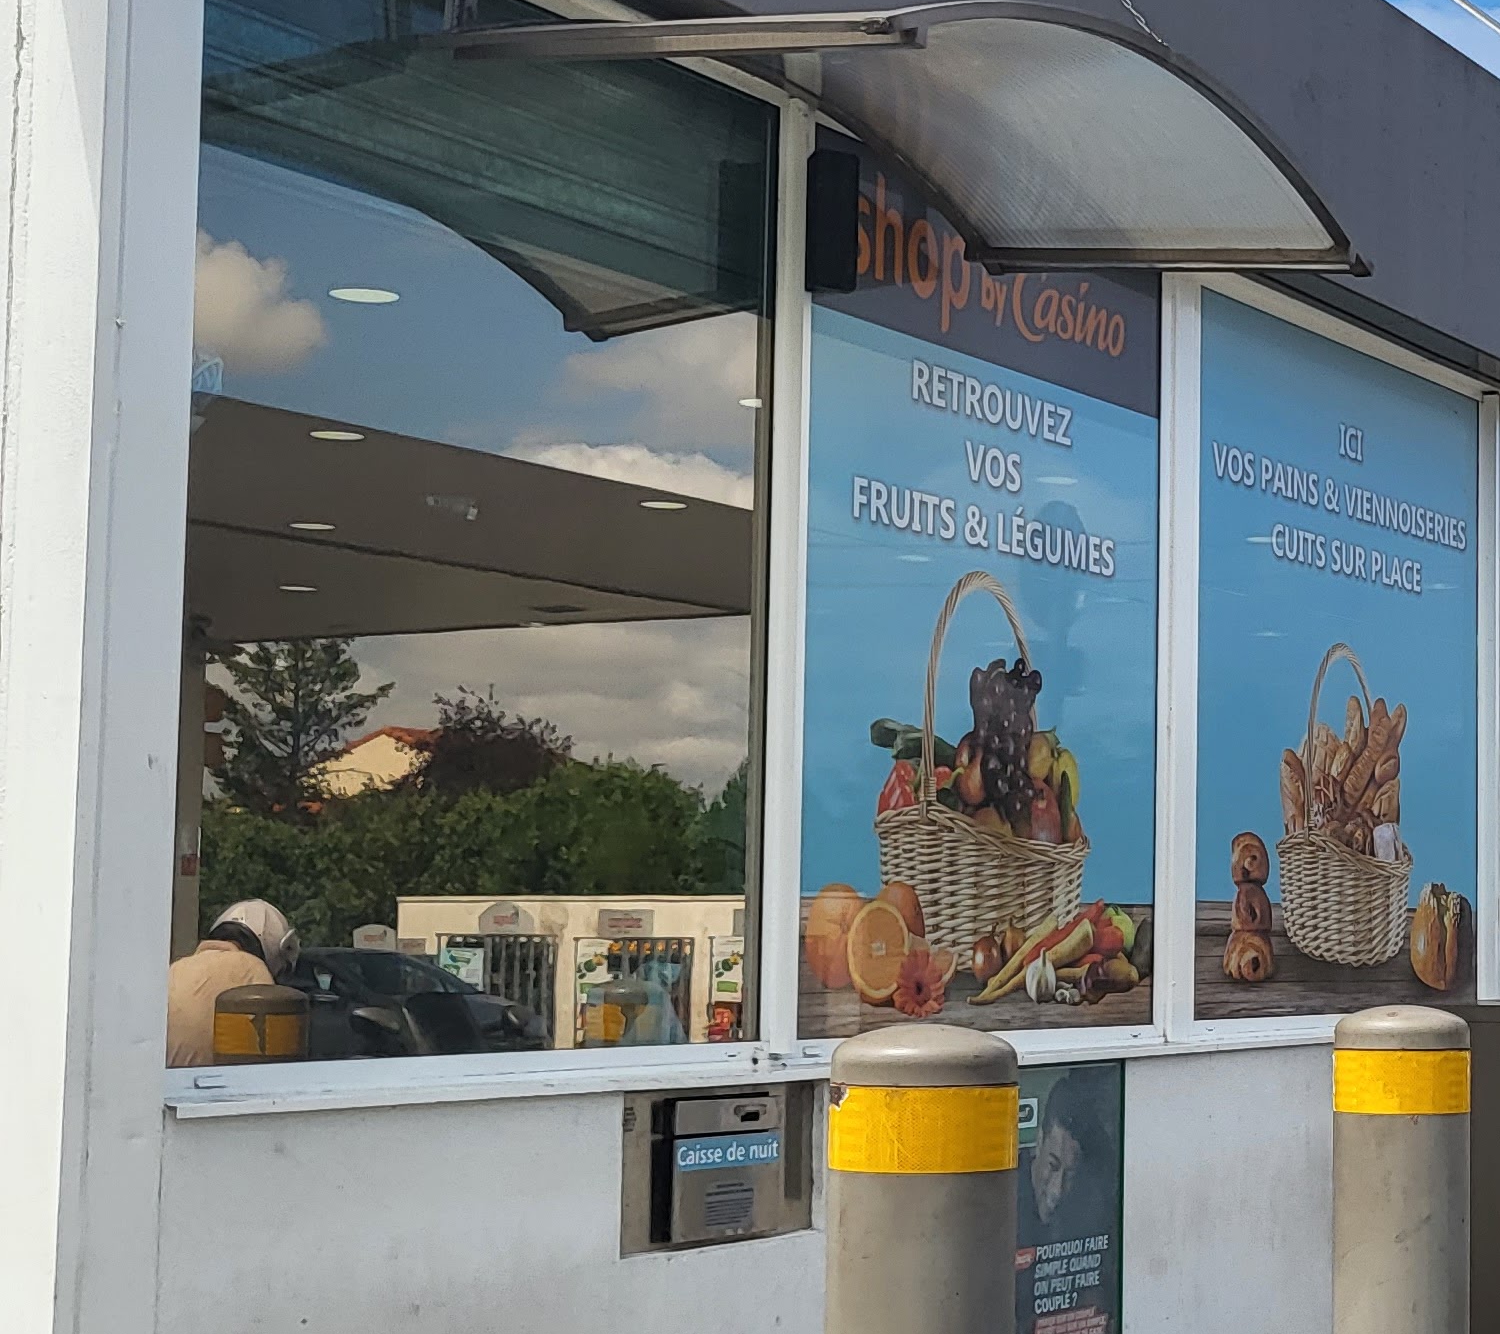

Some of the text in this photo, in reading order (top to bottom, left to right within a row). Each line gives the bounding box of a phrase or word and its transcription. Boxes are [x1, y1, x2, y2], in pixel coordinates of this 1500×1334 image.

[912, 359, 1072, 446] RETROUVEZ
[965, 441, 1021, 492] VOS
[1339, 424, 1363, 461] ICI
[1212, 441, 1466, 550] VOS PAINS & VIENNOISERIES
[853, 476, 1115, 577] FRUITS & LÉGUMES
[1271, 523, 1422, 593] CUITS SUR PLACE
[677, 1139, 779, 1166] Caisse de nuit
[1036, 1240, 1083, 1261] POURQUOI
[1083, 1235, 1109, 1253] FAIRE
[1075, 1270, 1100, 1288] FAIRE
